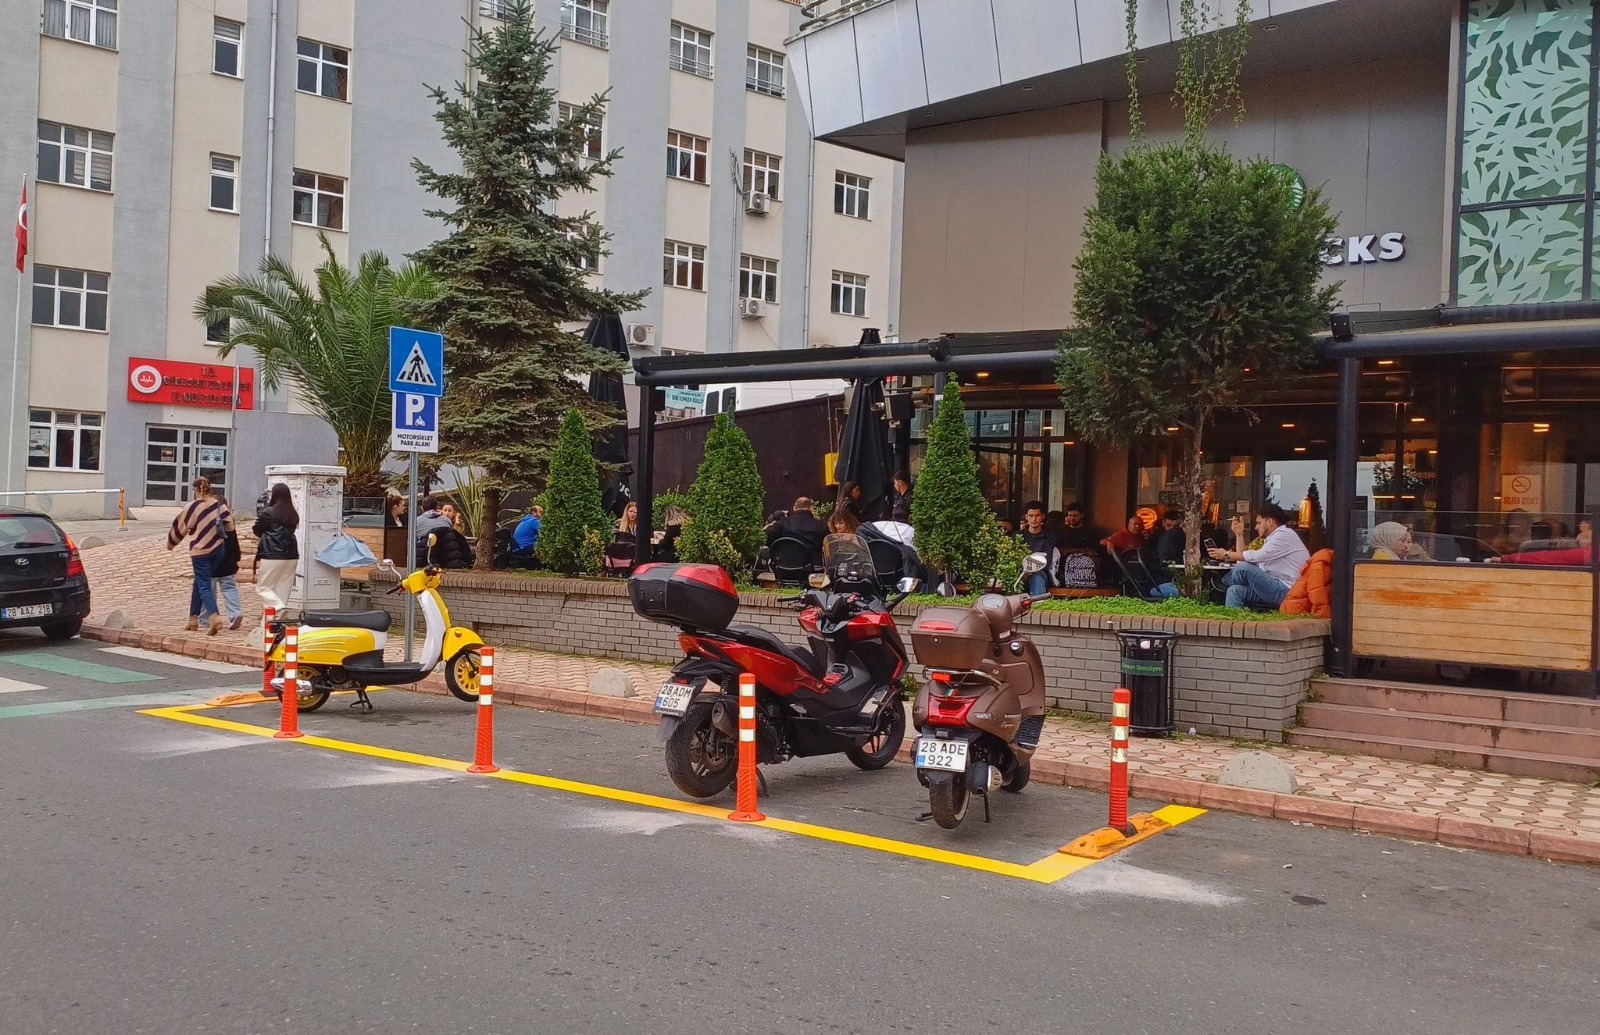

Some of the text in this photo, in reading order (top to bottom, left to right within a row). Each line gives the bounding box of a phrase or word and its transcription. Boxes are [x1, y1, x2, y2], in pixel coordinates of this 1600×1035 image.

[405, 393, 425, 426] P
[397, 433, 433, 441] MOTORSİKLET
[7, 604, 51, 617] 28 AAZ 218
[661, 685, 692, 698] 28 ADM
[662, 697, 680, 708] 605
[921, 741, 966, 755] 28 ADE
[928, 754, 953, 767] 922
